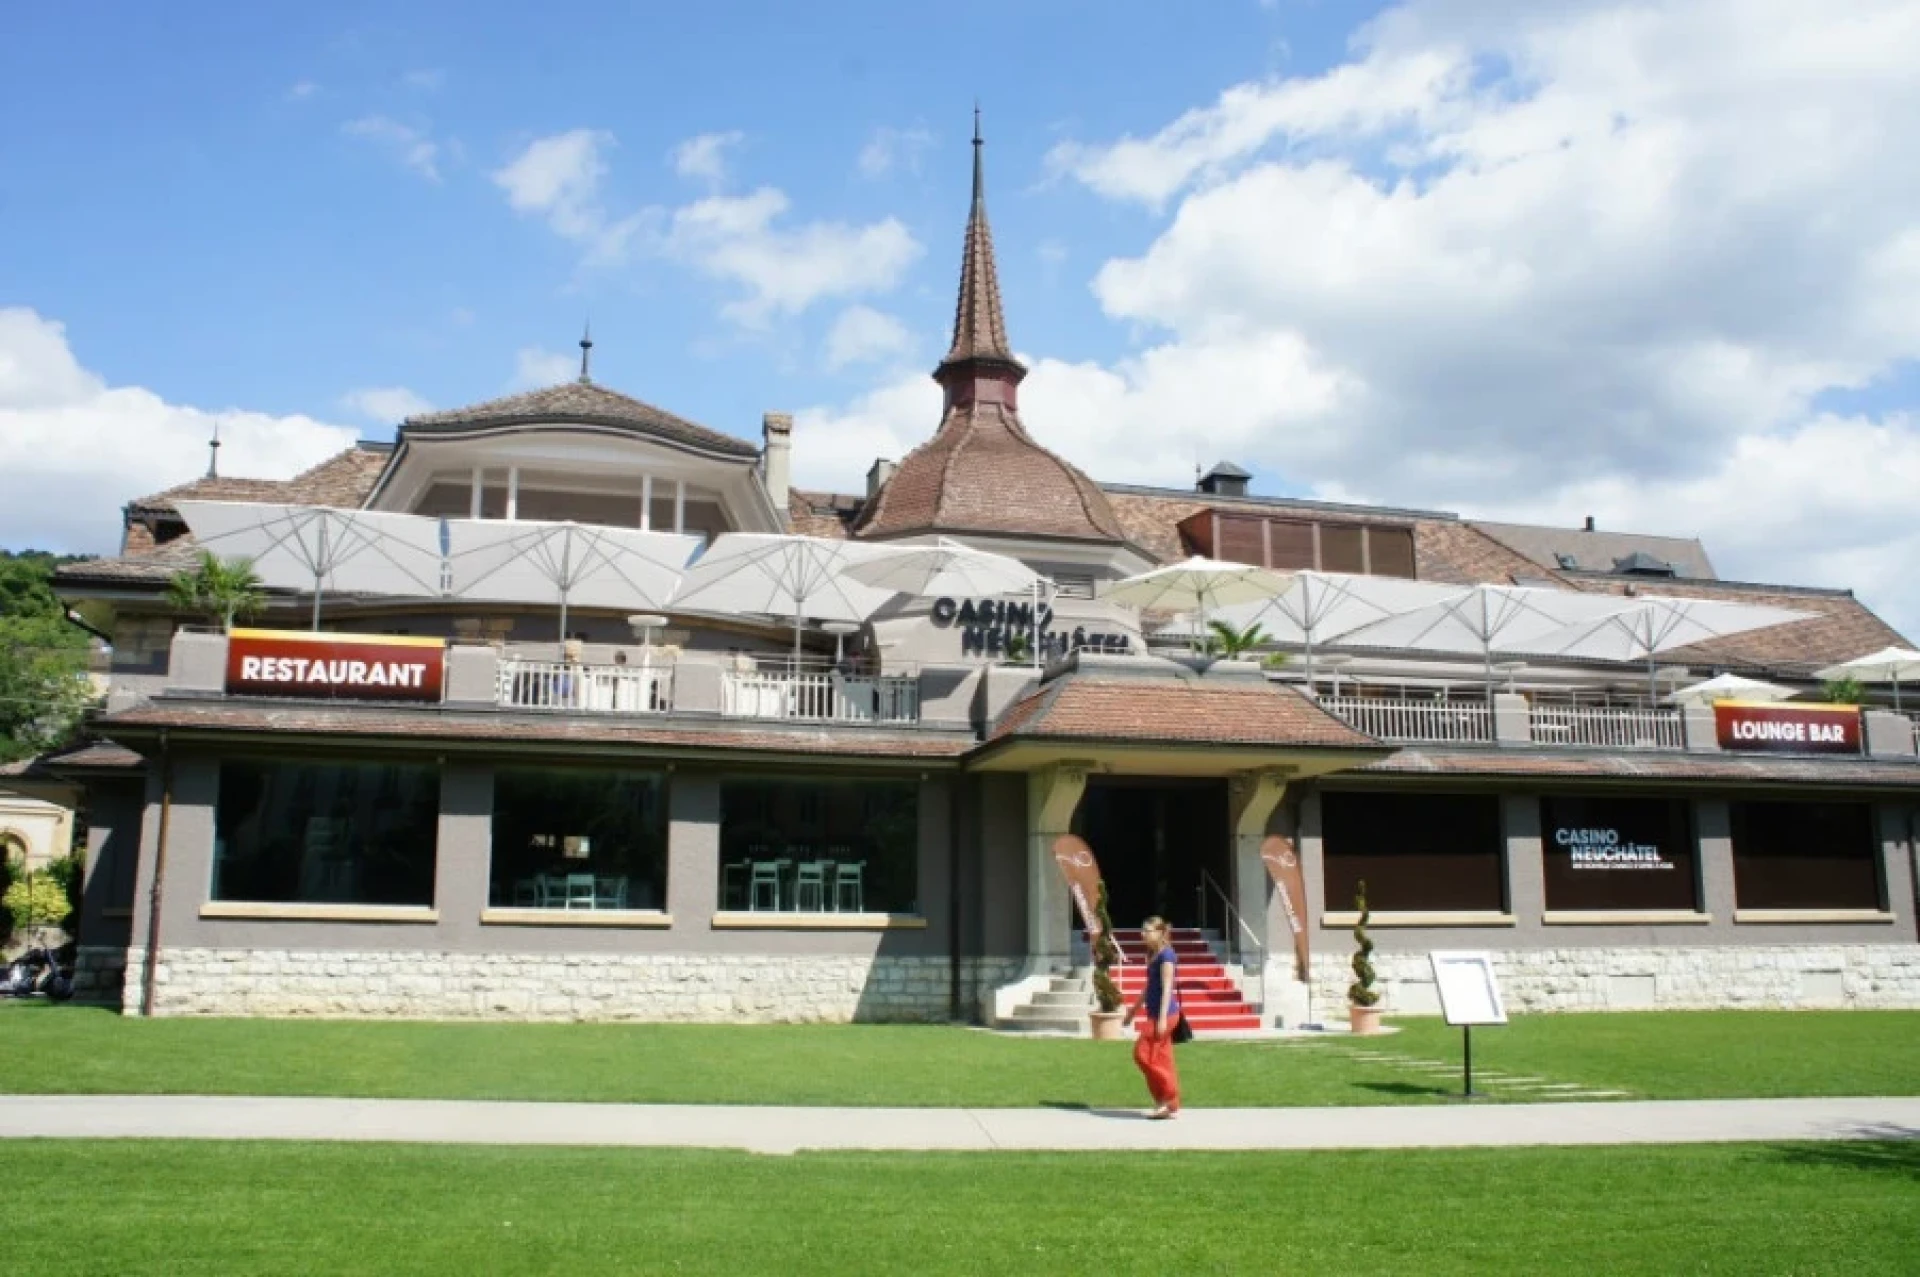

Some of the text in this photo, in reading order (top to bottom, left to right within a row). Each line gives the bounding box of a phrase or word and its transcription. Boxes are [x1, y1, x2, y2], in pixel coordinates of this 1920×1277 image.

[931, 597, 1053, 629] CASINO
[241, 655, 427, 687] RESTAURANT
[1732, 720, 1845, 742] LOUNGE BAR
[1555, 828, 1619, 845] CASINO
[1572, 842, 1661, 861] NEUCHÂTEL
